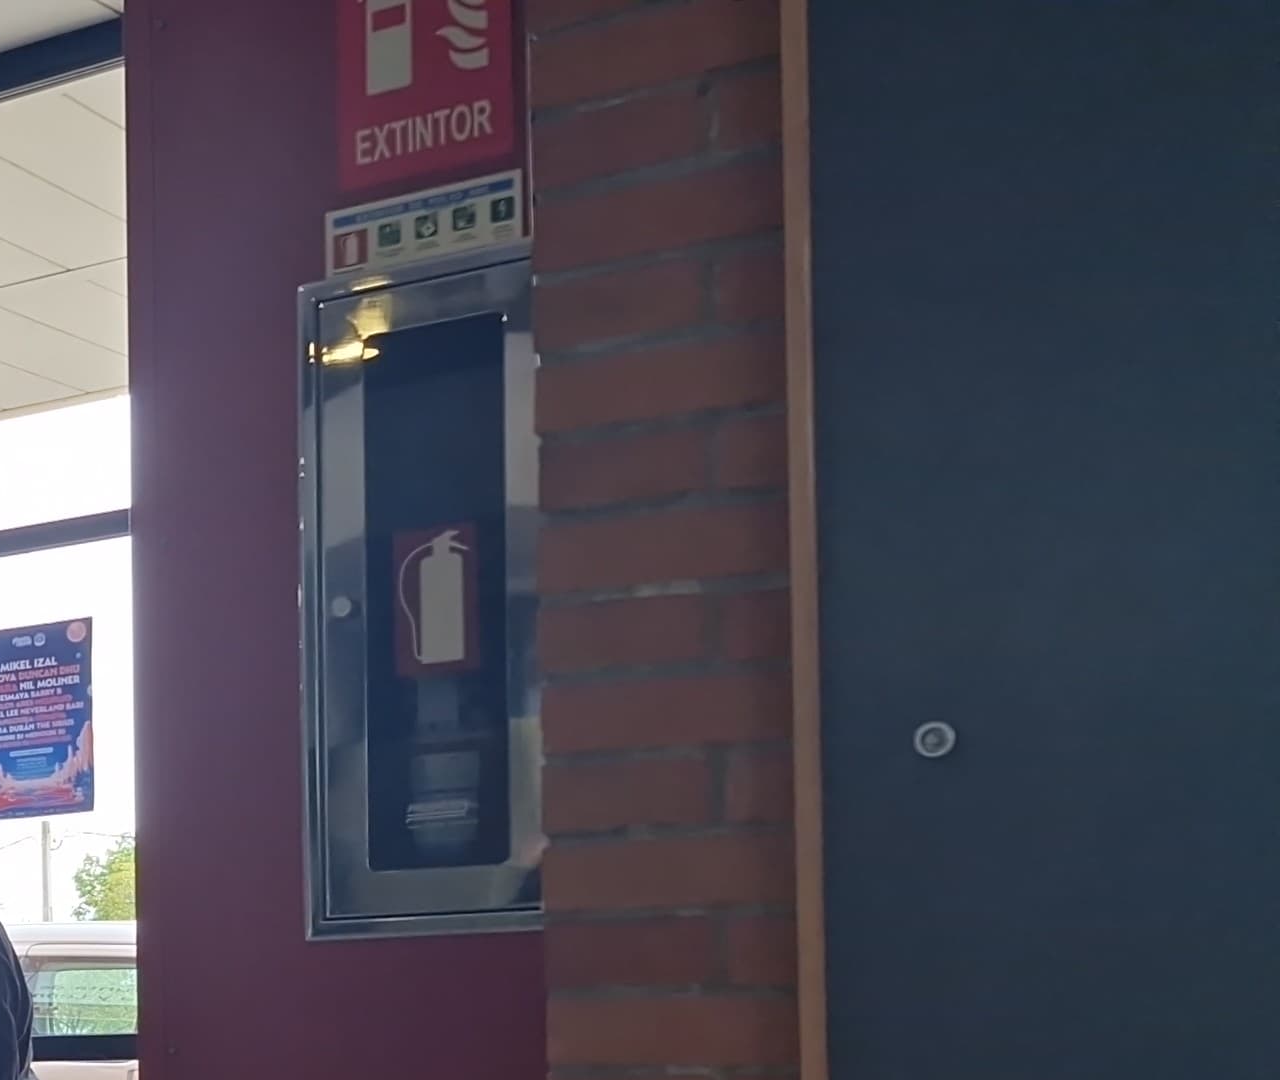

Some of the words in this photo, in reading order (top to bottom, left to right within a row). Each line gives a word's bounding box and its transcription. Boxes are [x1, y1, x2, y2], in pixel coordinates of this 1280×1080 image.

[355, 99, 493, 166] EXTINTOR
[0, 660, 31, 672] MIKEL
[34, 656, 57, 667] IZAL
[20, 680, 35, 690] NIL
[37, 675, 80, 689] MOLINER
